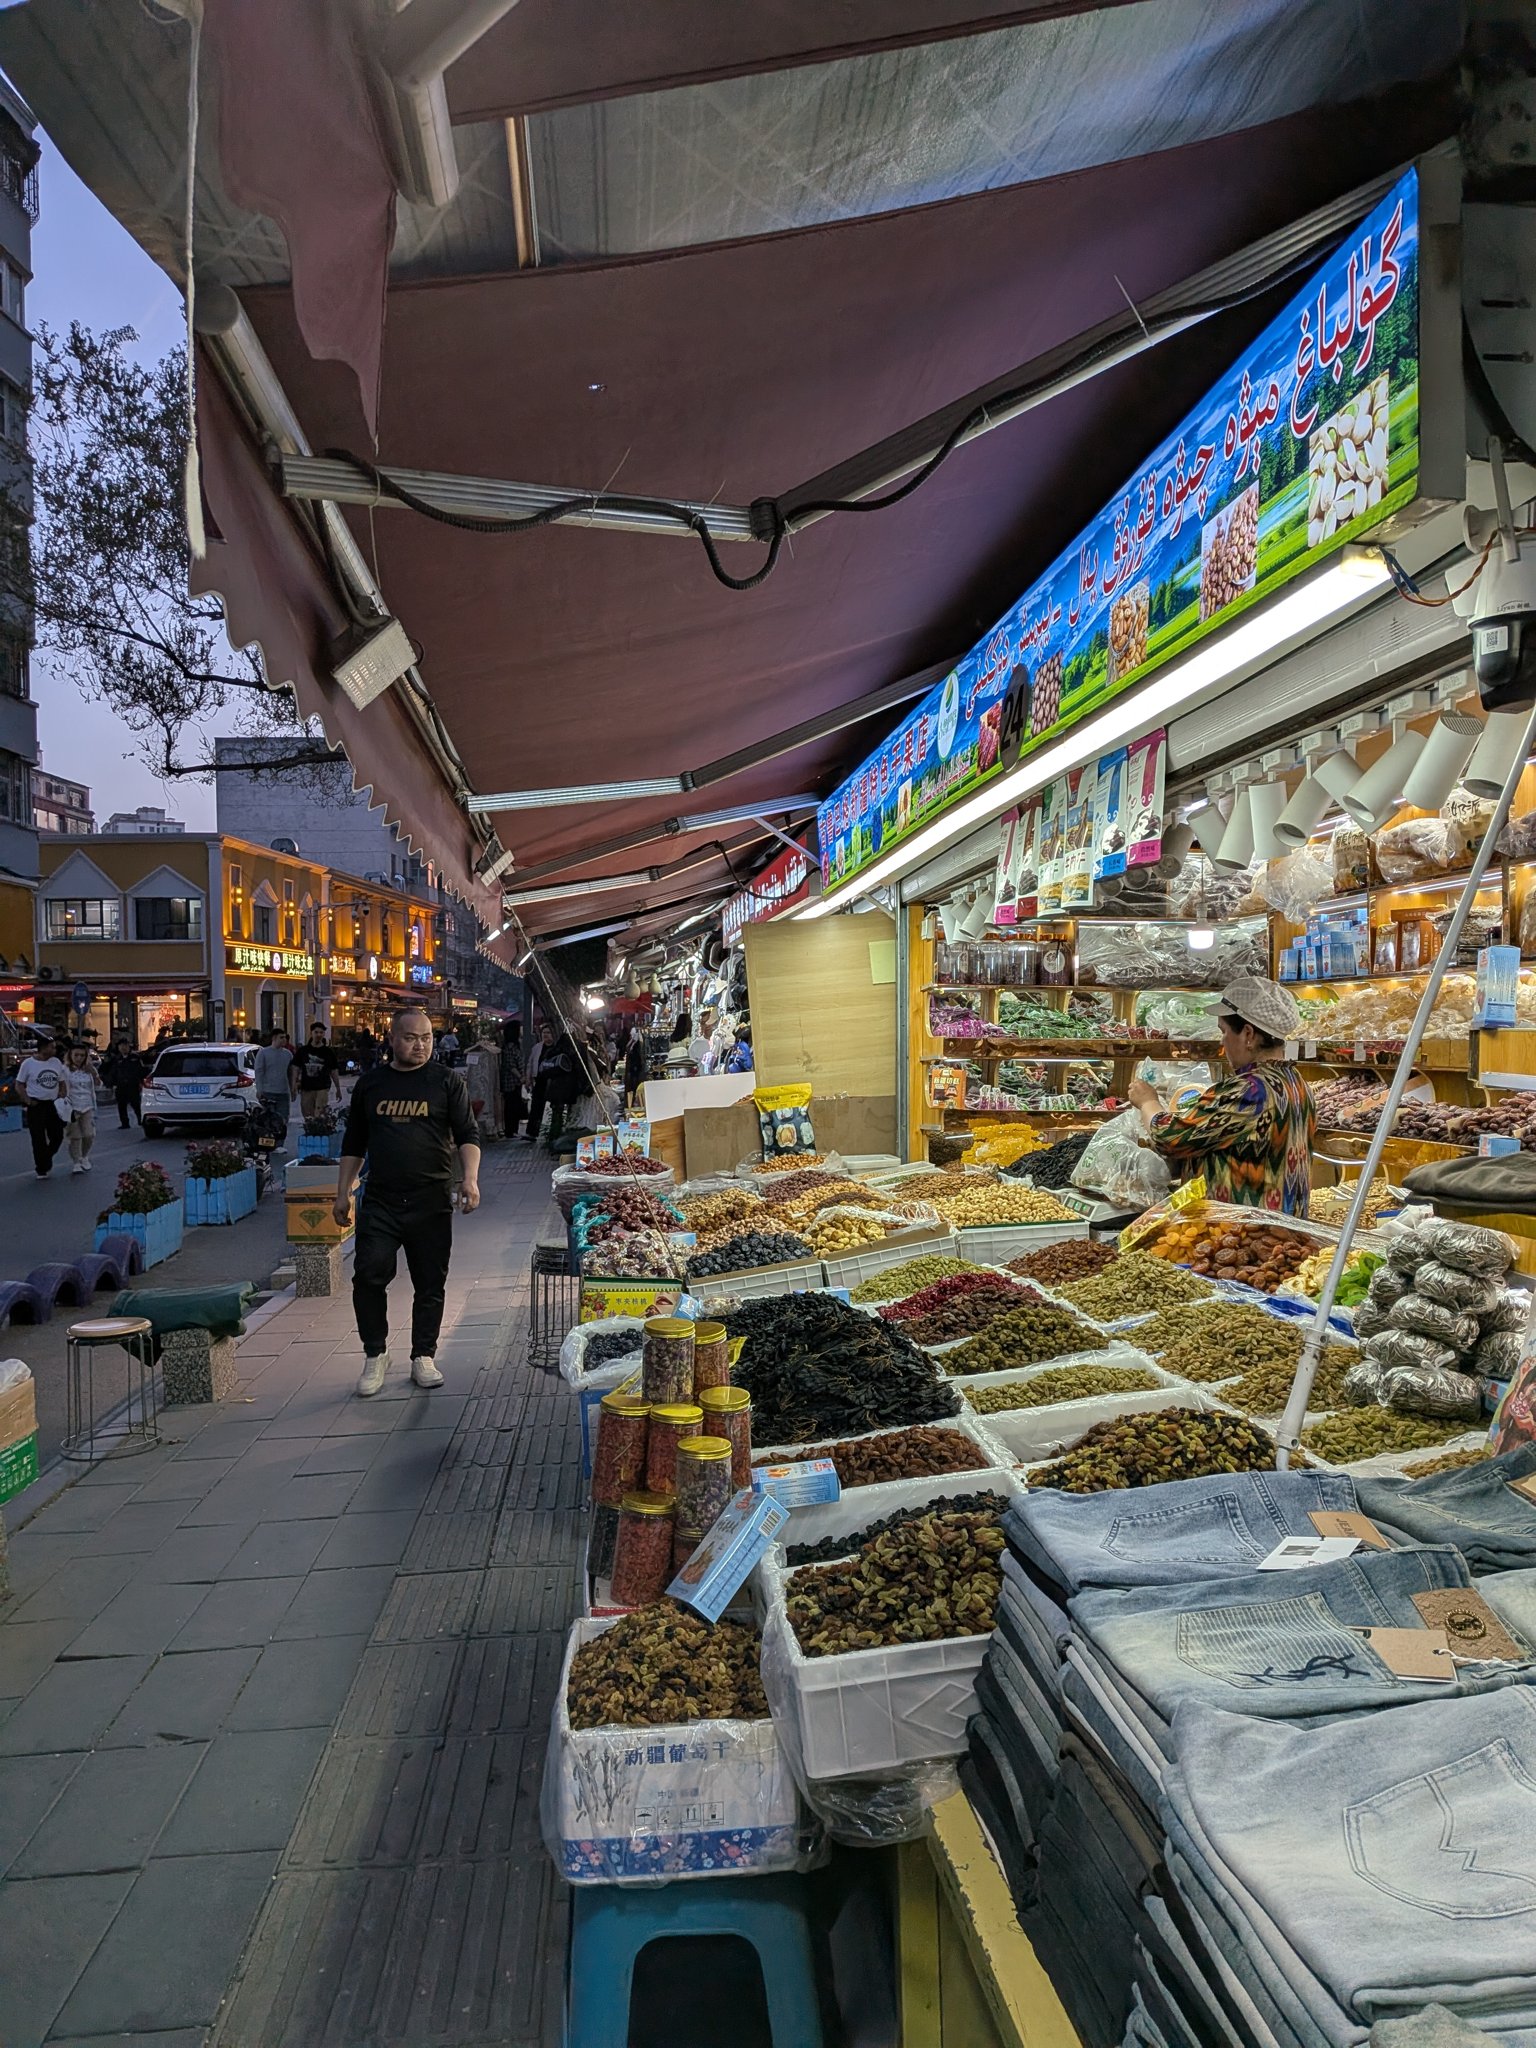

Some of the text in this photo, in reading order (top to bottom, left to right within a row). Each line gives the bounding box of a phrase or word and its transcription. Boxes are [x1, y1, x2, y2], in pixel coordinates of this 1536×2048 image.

[1001, 684, 1024, 748] 24
[234, 948, 271, 967] 原汁味快餐
[376, 1100, 429, 1117] CHINA
[624, 1741, 730, 1767] 新疆葡萄干
